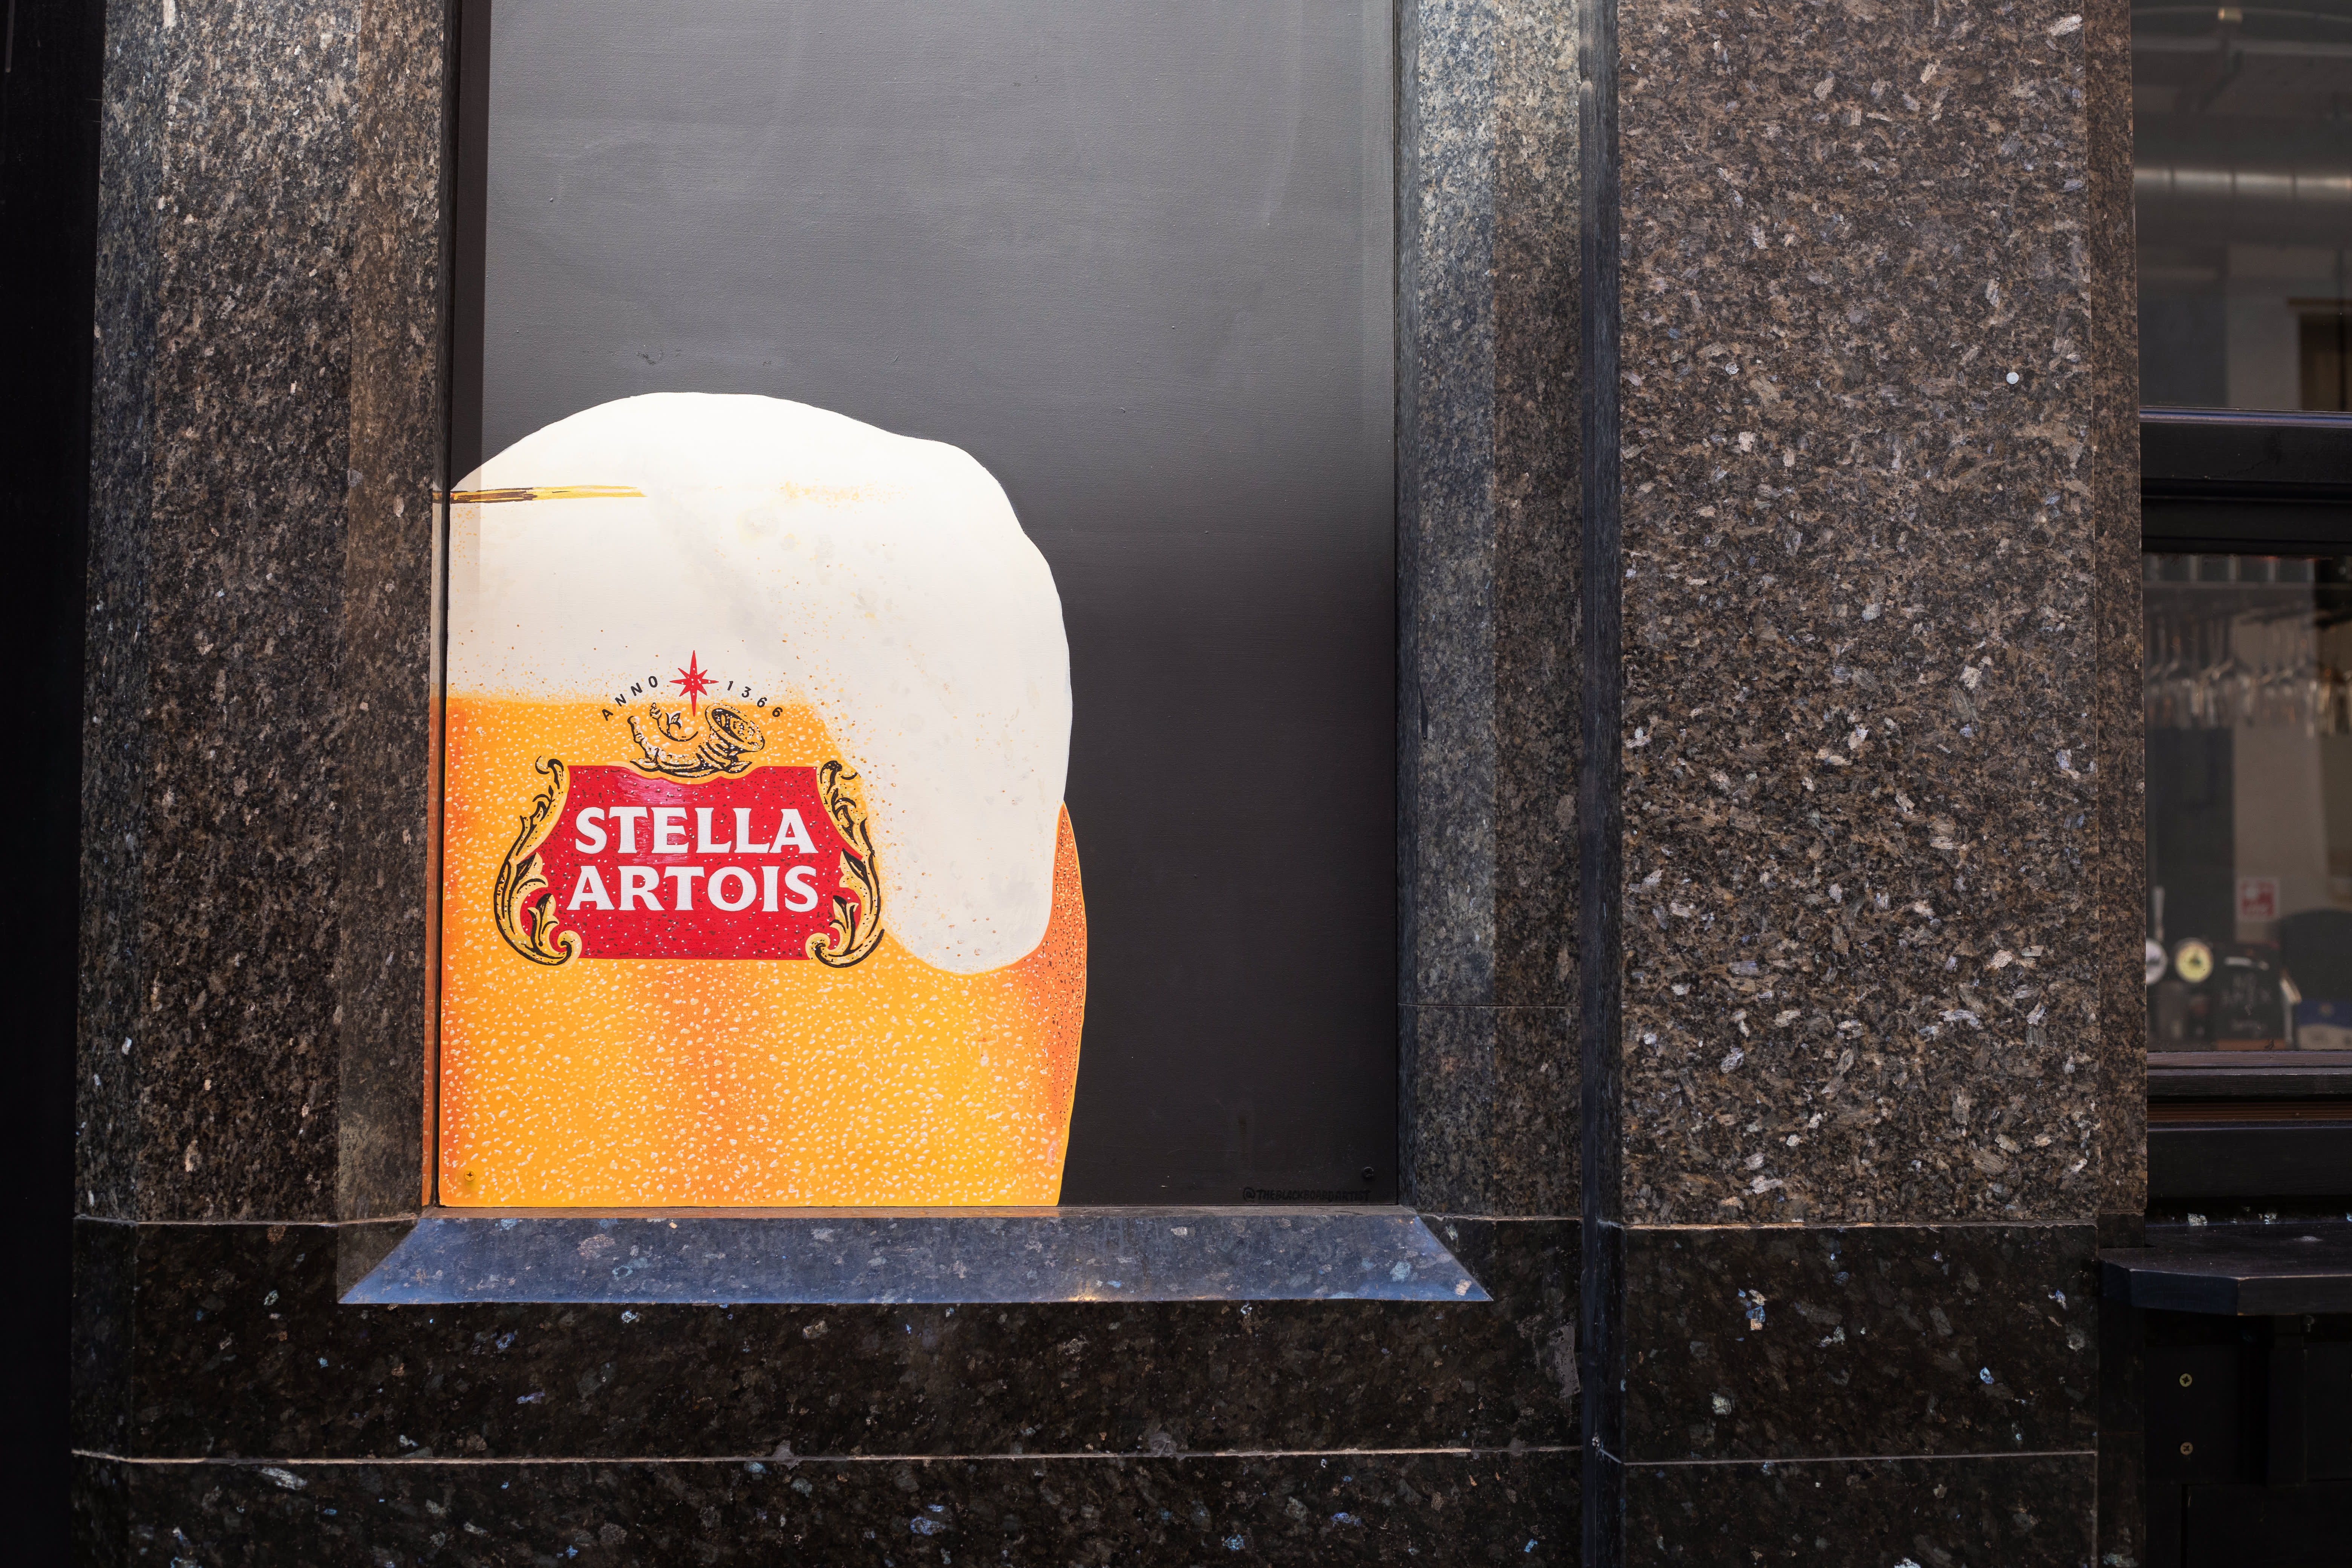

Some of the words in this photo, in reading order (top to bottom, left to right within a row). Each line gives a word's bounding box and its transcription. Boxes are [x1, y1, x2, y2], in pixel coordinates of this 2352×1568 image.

[602, 675, 658, 721] ANNO
[727, 680, 783, 718] 1366
[575, 806, 819, 854] STELLA
[566, 865, 819, 913] ARTOIS
